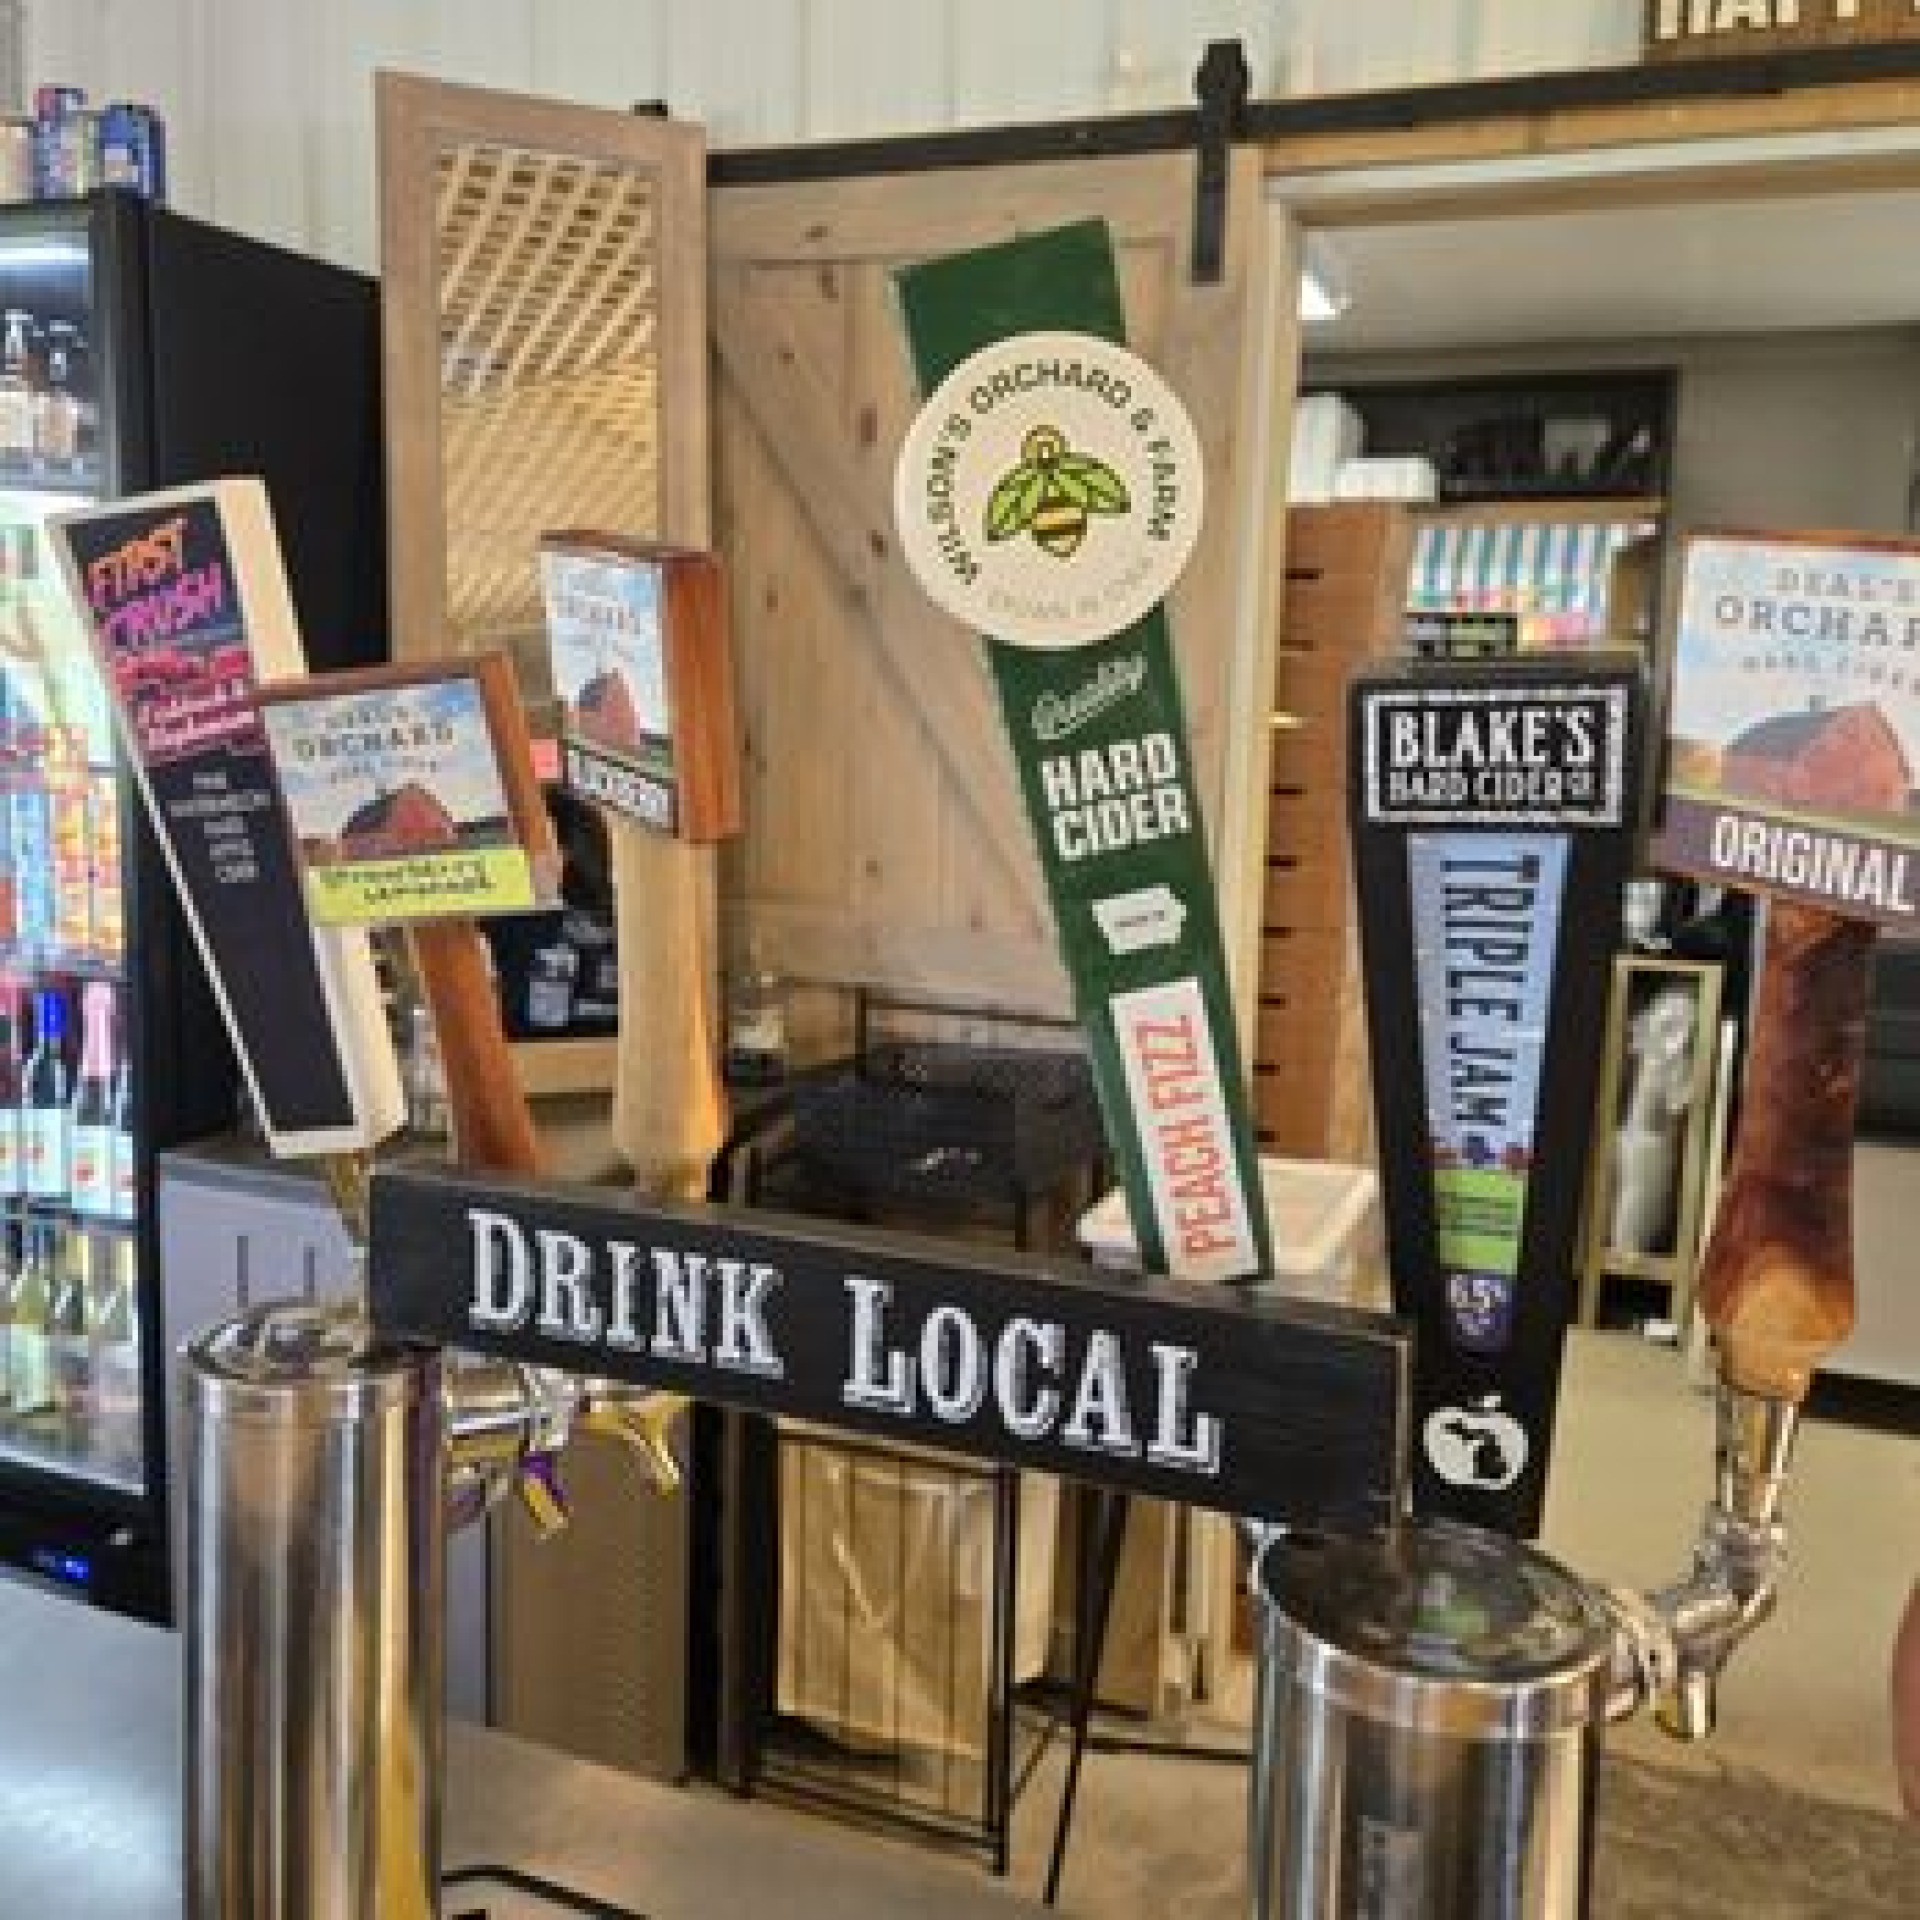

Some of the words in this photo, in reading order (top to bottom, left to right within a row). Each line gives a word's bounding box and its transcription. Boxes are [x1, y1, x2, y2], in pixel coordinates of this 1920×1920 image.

[925, 411, 983, 586] WILSON'S
[970, 357, 1133, 415] ORCHARD
[1130, 405, 1154, 432] &
[1146, 435, 1178, 542] FARM
[86, 517, 188, 608] FIRST
[104, 561, 222, 650] CRUSH
[1041, 732, 1178, 808] HARD
[1389, 704, 1597, 768] BLAKE'S
[1053, 783, 1192, 862] CIDER
[1388, 771, 1470, 803] HARD
[1472, 766, 1563, 803] CIDER
[1709, 814, 1916, 912] ORIGINAL
[1440, 854, 1541, 1020] TRIPLE
[1134, 1014, 1207, 1110] FIZZ
[1446, 1034, 1516, 1127] JAM
[1157, 1113, 1238, 1256] PEACH
[465, 1207, 785, 1380] DRINK
[842, 1275, 1222, 1474] LOCAL
